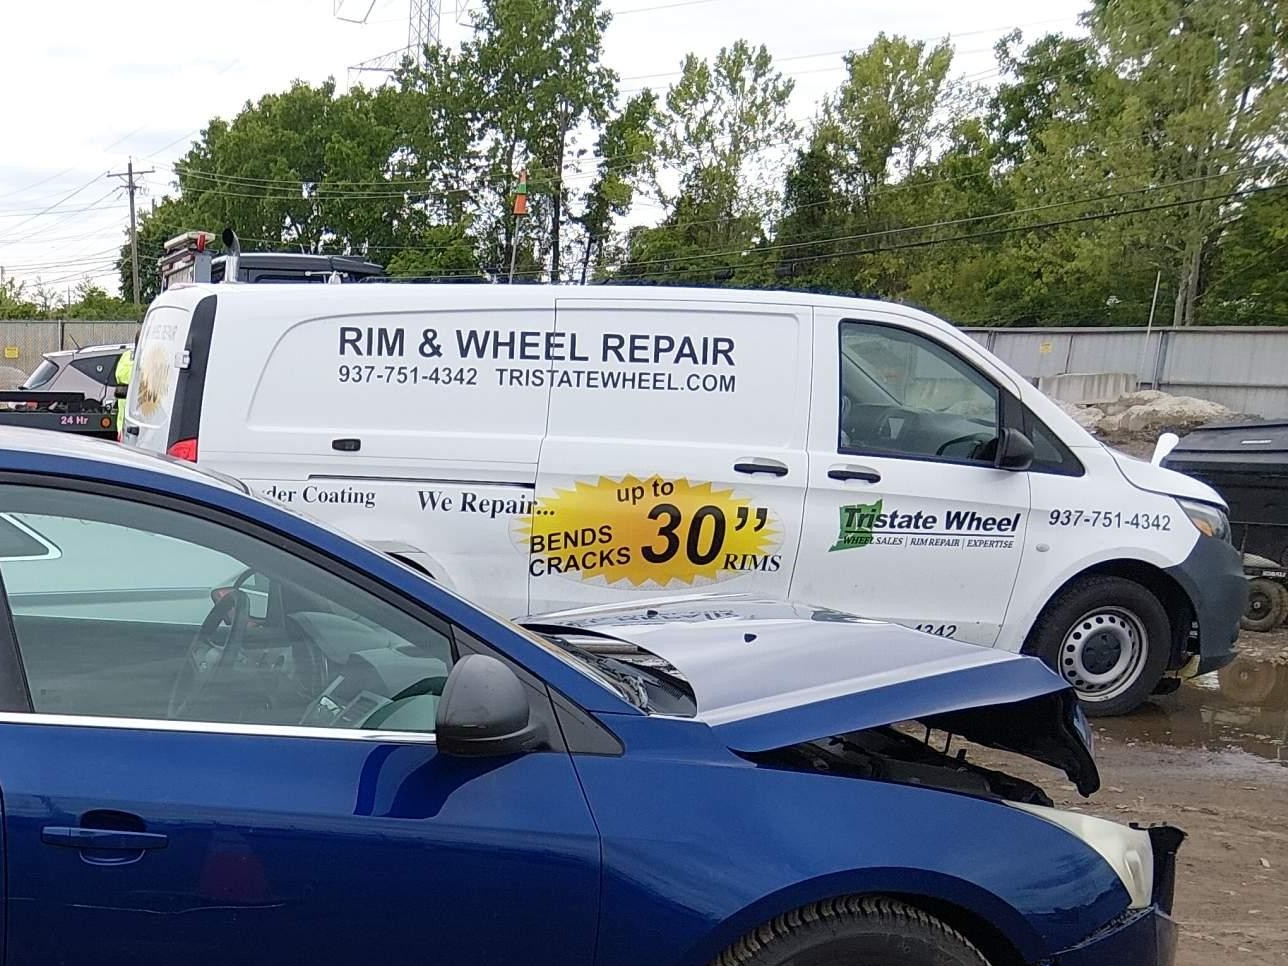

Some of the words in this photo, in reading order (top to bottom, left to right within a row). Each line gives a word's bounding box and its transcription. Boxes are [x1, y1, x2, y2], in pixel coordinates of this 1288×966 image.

[339, 326, 405, 357] RIM
[418, 328, 443, 358] &
[456, 329, 589, 361] WHEEL
[602, 333, 735, 366] REPAIR
[338, 365, 478, 385] 937-751-4342
[495, 368, 736, 392] TRISTATEWHEEL.COM
[60, 416, 73, 425] 24
[76, 416, 89, 425] Hr
[302, 485, 376, 508] Coating
[417, 490, 453, 512] We
[459, 491, 556, 518] Repair...
[617, 485, 645, 505] up
[652, 479, 674, 497] to
[843, 507, 938, 530] Tristate
[945, 510, 1022, 532] Wheel
[1048, 508, 1171, 531] 937-751-4342
[530, 525, 613, 554] BENDS
[842, 535, 874, 545] WHEEL
[875, 536, 904, 546] SALES
[910, 537, 928, 546] RIM
[928, 538, 960, 547] REPAIR
[966, 539, 1014, 549] EXPERTISE
[529, 547, 631, 577] CRACKS
[723, 553, 782, 572] RIMS
